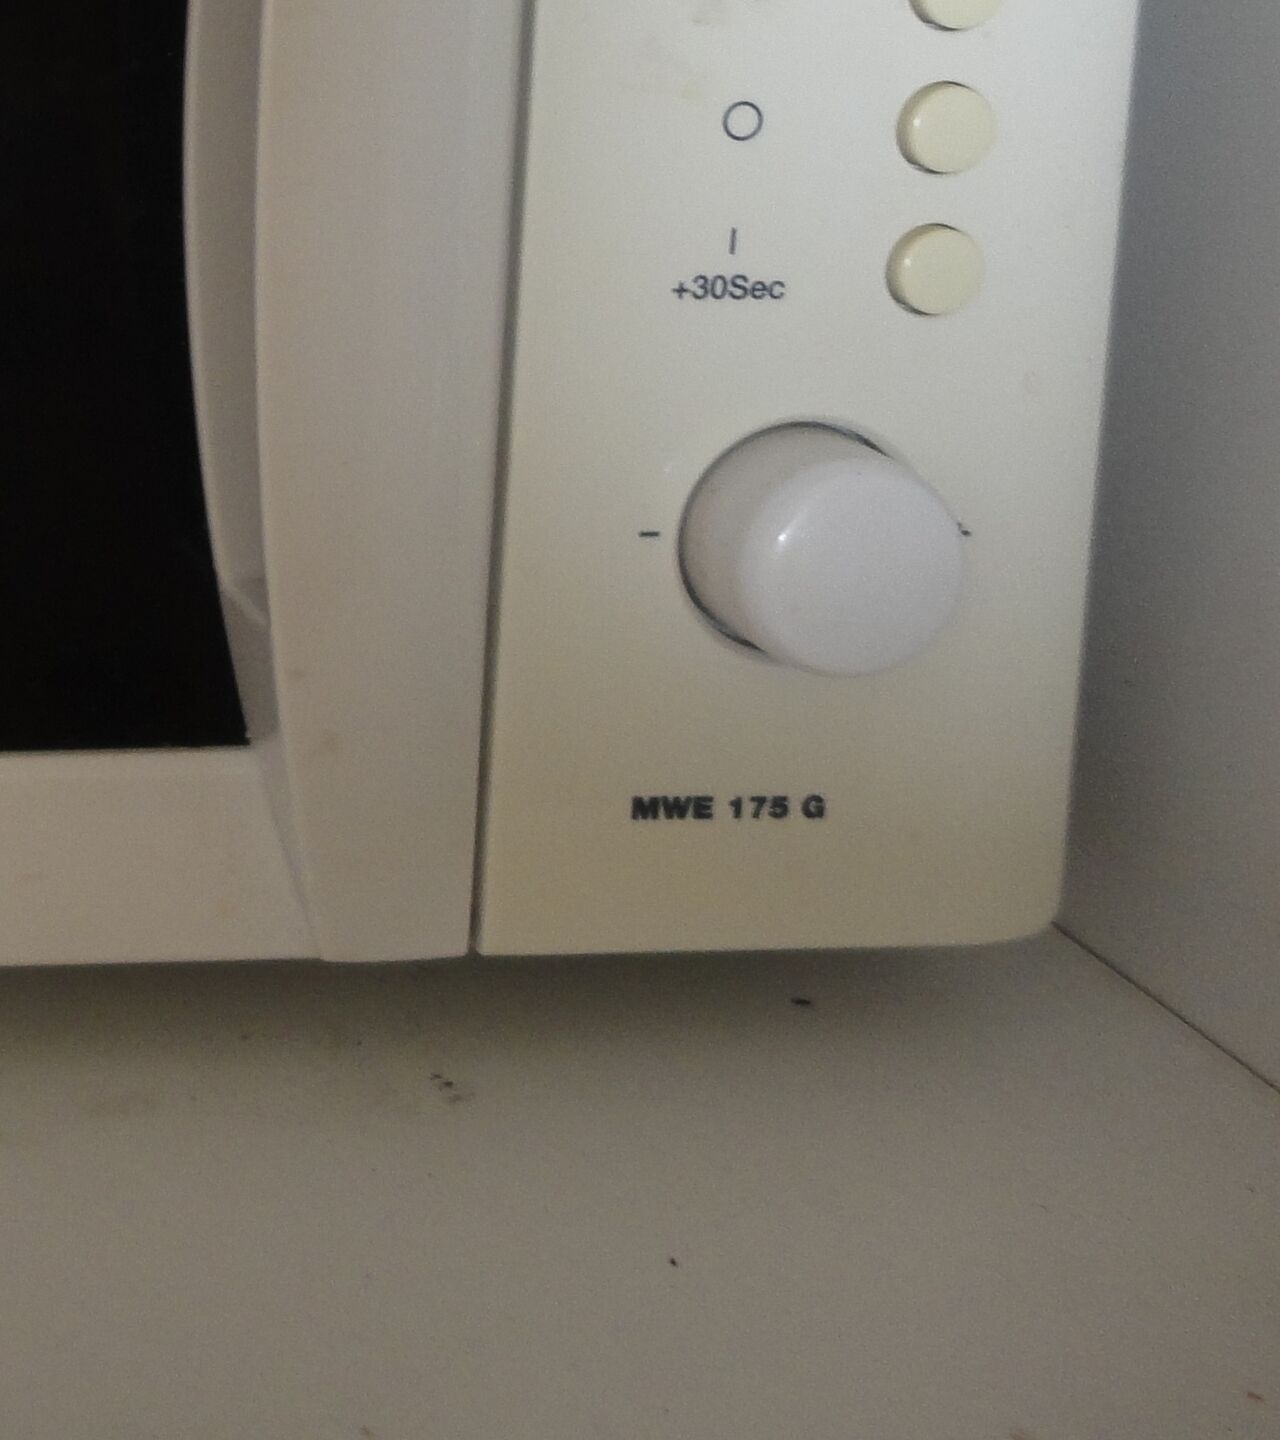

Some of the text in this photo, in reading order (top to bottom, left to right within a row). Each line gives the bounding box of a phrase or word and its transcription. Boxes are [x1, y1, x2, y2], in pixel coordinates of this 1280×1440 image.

[671, 274, 786, 302] +30Sec
[631, 795, 826, 820] MWE 175 G
